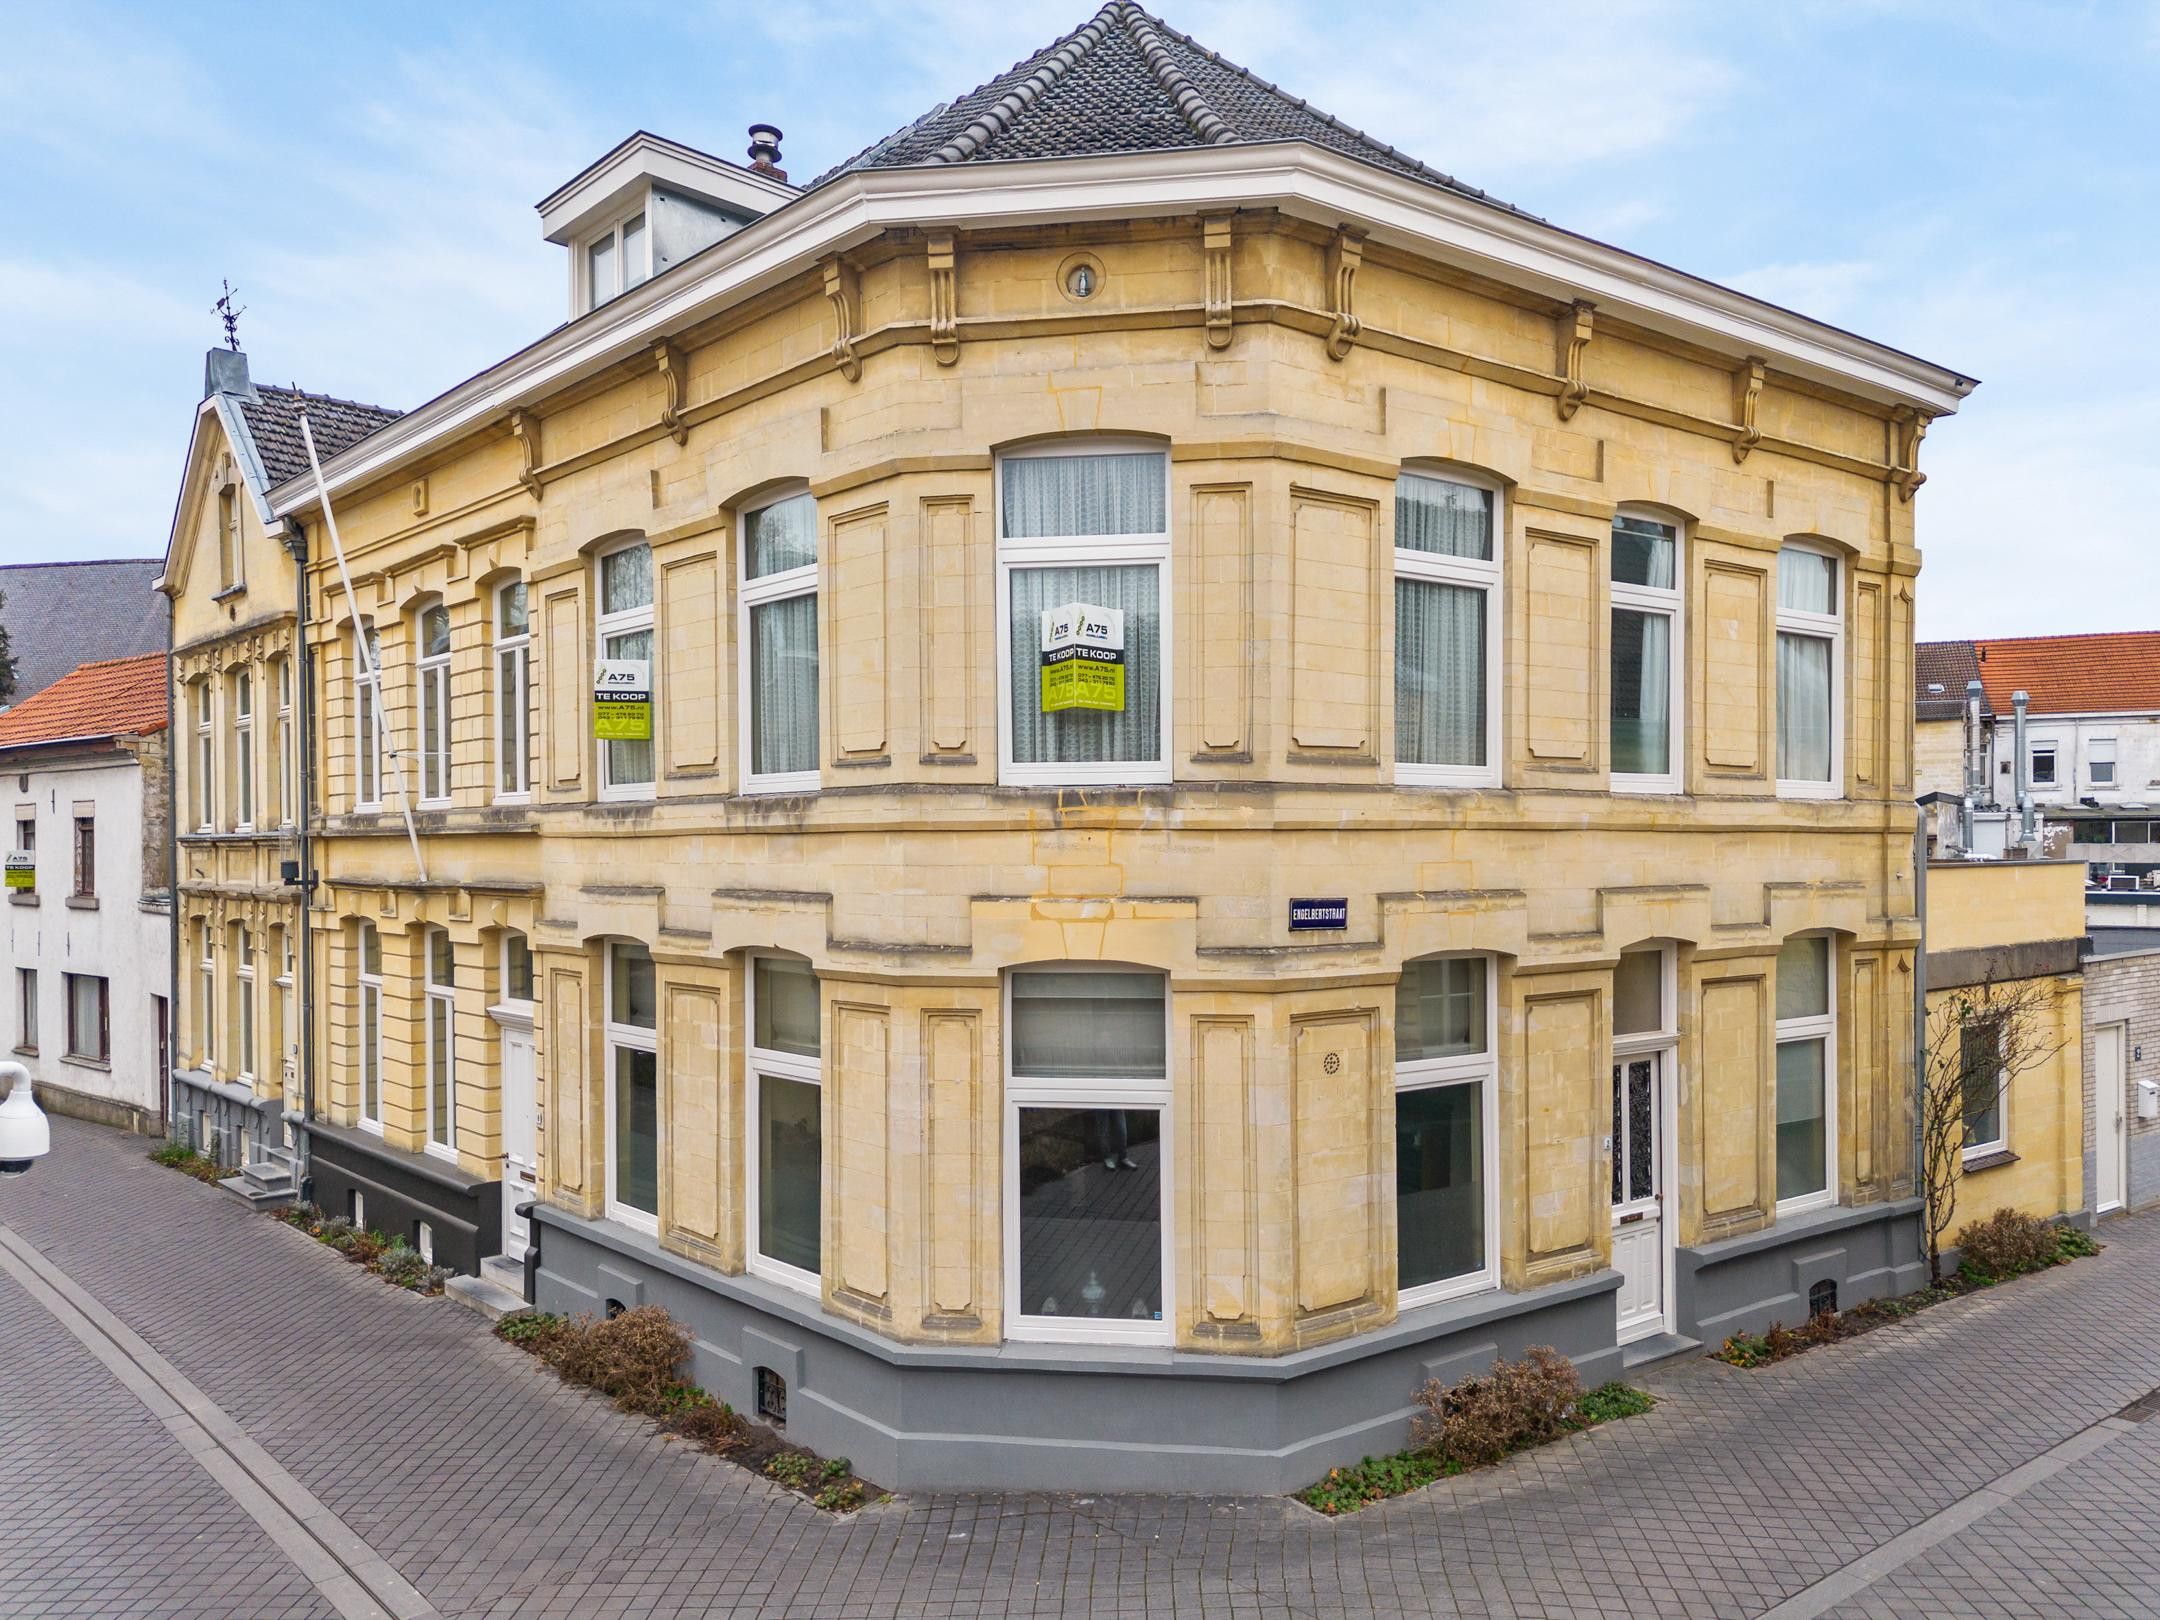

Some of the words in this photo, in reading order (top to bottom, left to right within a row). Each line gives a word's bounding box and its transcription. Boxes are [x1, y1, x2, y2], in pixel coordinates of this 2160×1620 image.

[1054, 623, 1069, 636] A75
[1086, 623, 1108, 635] A75
[1049, 653, 1057, 662] TE
[1057, 648, 1074, 660] KOOP
[1076, 648, 1088, 657] TE
[1089, 649, 1117, 660] KOOP
[1077, 663, 1116, 674] www.A75.nl
[608, 673, 635, 681] A75
[1077, 682, 1116, 699] A75
[596, 719, 645, 731] A75
[1293, 908, 1345, 920] ENGELBERTSTRAAT
